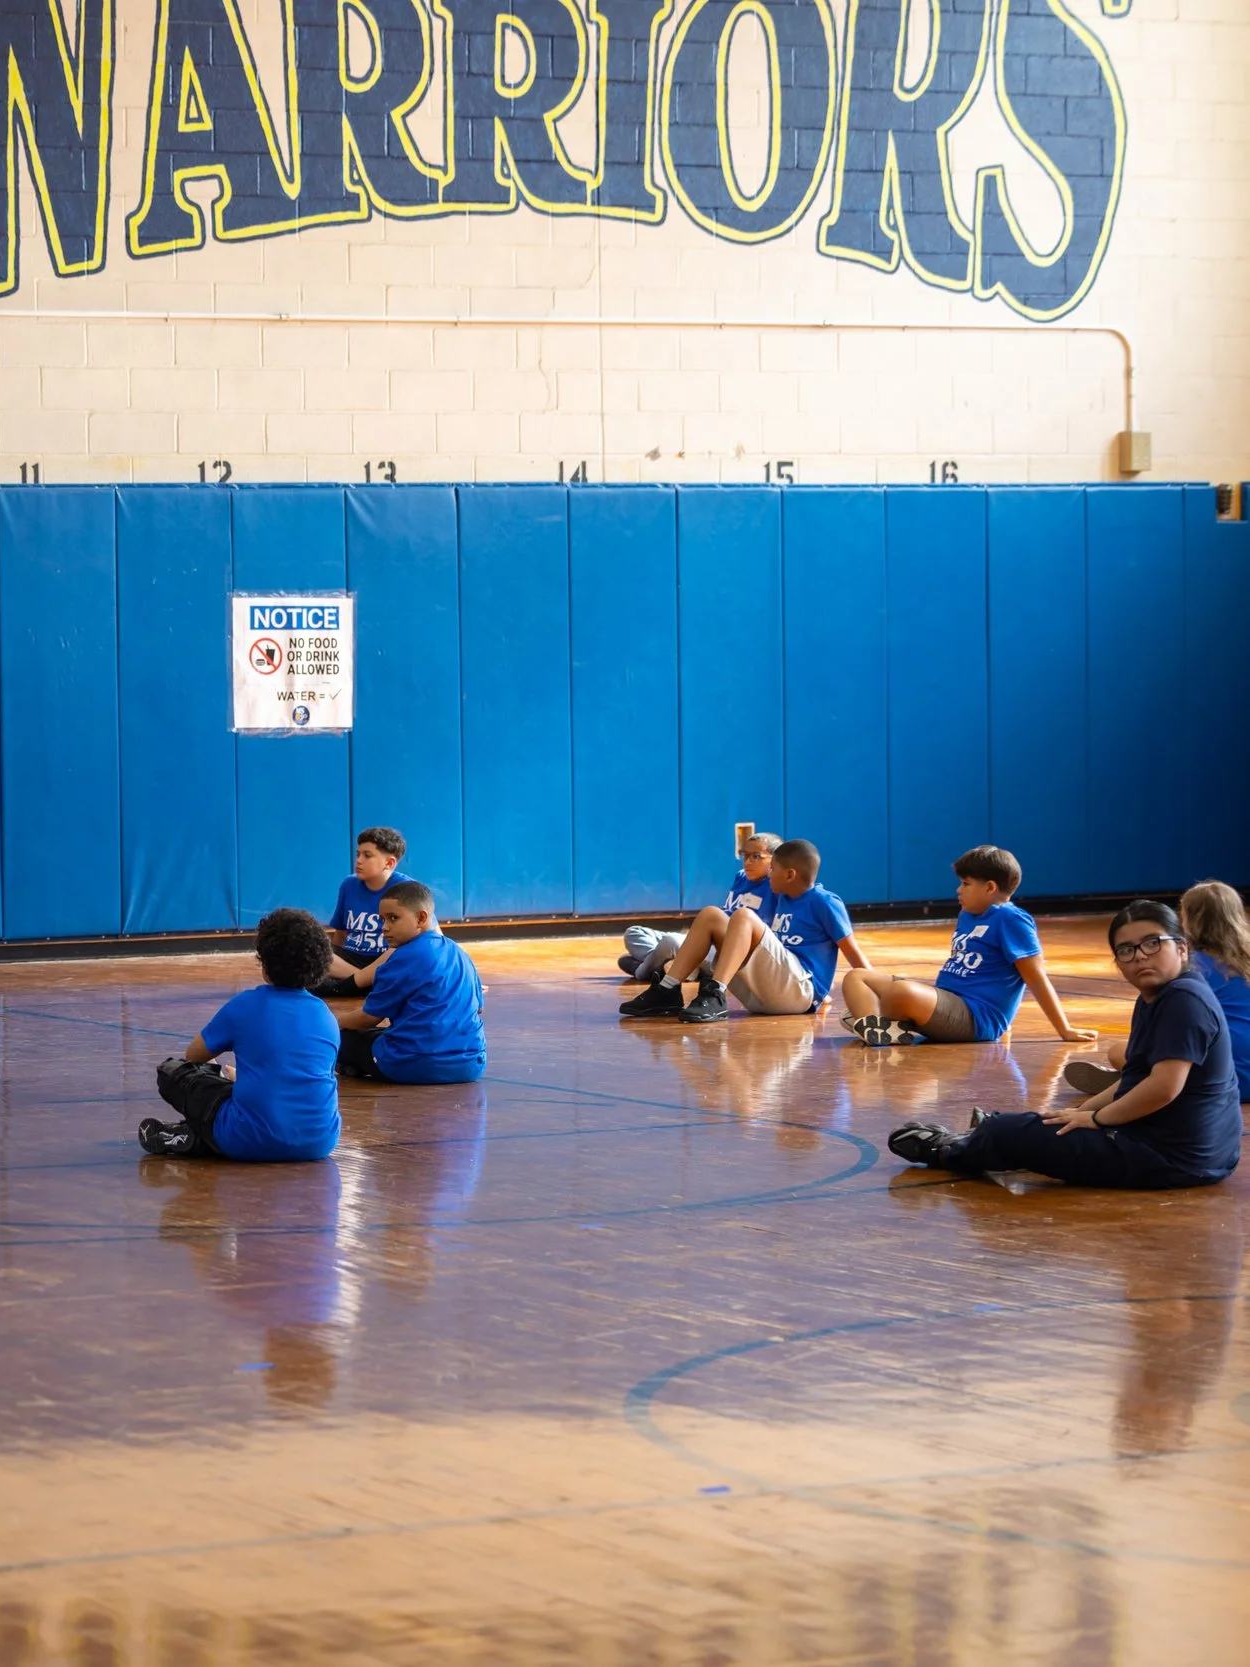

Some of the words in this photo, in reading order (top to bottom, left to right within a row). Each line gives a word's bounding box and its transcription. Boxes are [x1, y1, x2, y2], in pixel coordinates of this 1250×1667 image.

[20, 462, 39, 484] 11
[198, 461, 232, 483] 12
[364, 461, 397, 483] 13
[558, 461, 588, 483] 14
[763, 461, 794, 484] 15
[929, 461, 958, 484] 16
[253, 608, 338, 629] NOTICE
[289, 637, 305, 649] NO
[308, 637, 338, 649] FOOD
[287, 650, 303, 662] OR
[306, 650, 340, 662] DRINK
[287, 663, 340, 675] ALLOWED
[277, 691, 316, 701] WATER
[346, 909, 380, 932] MS
